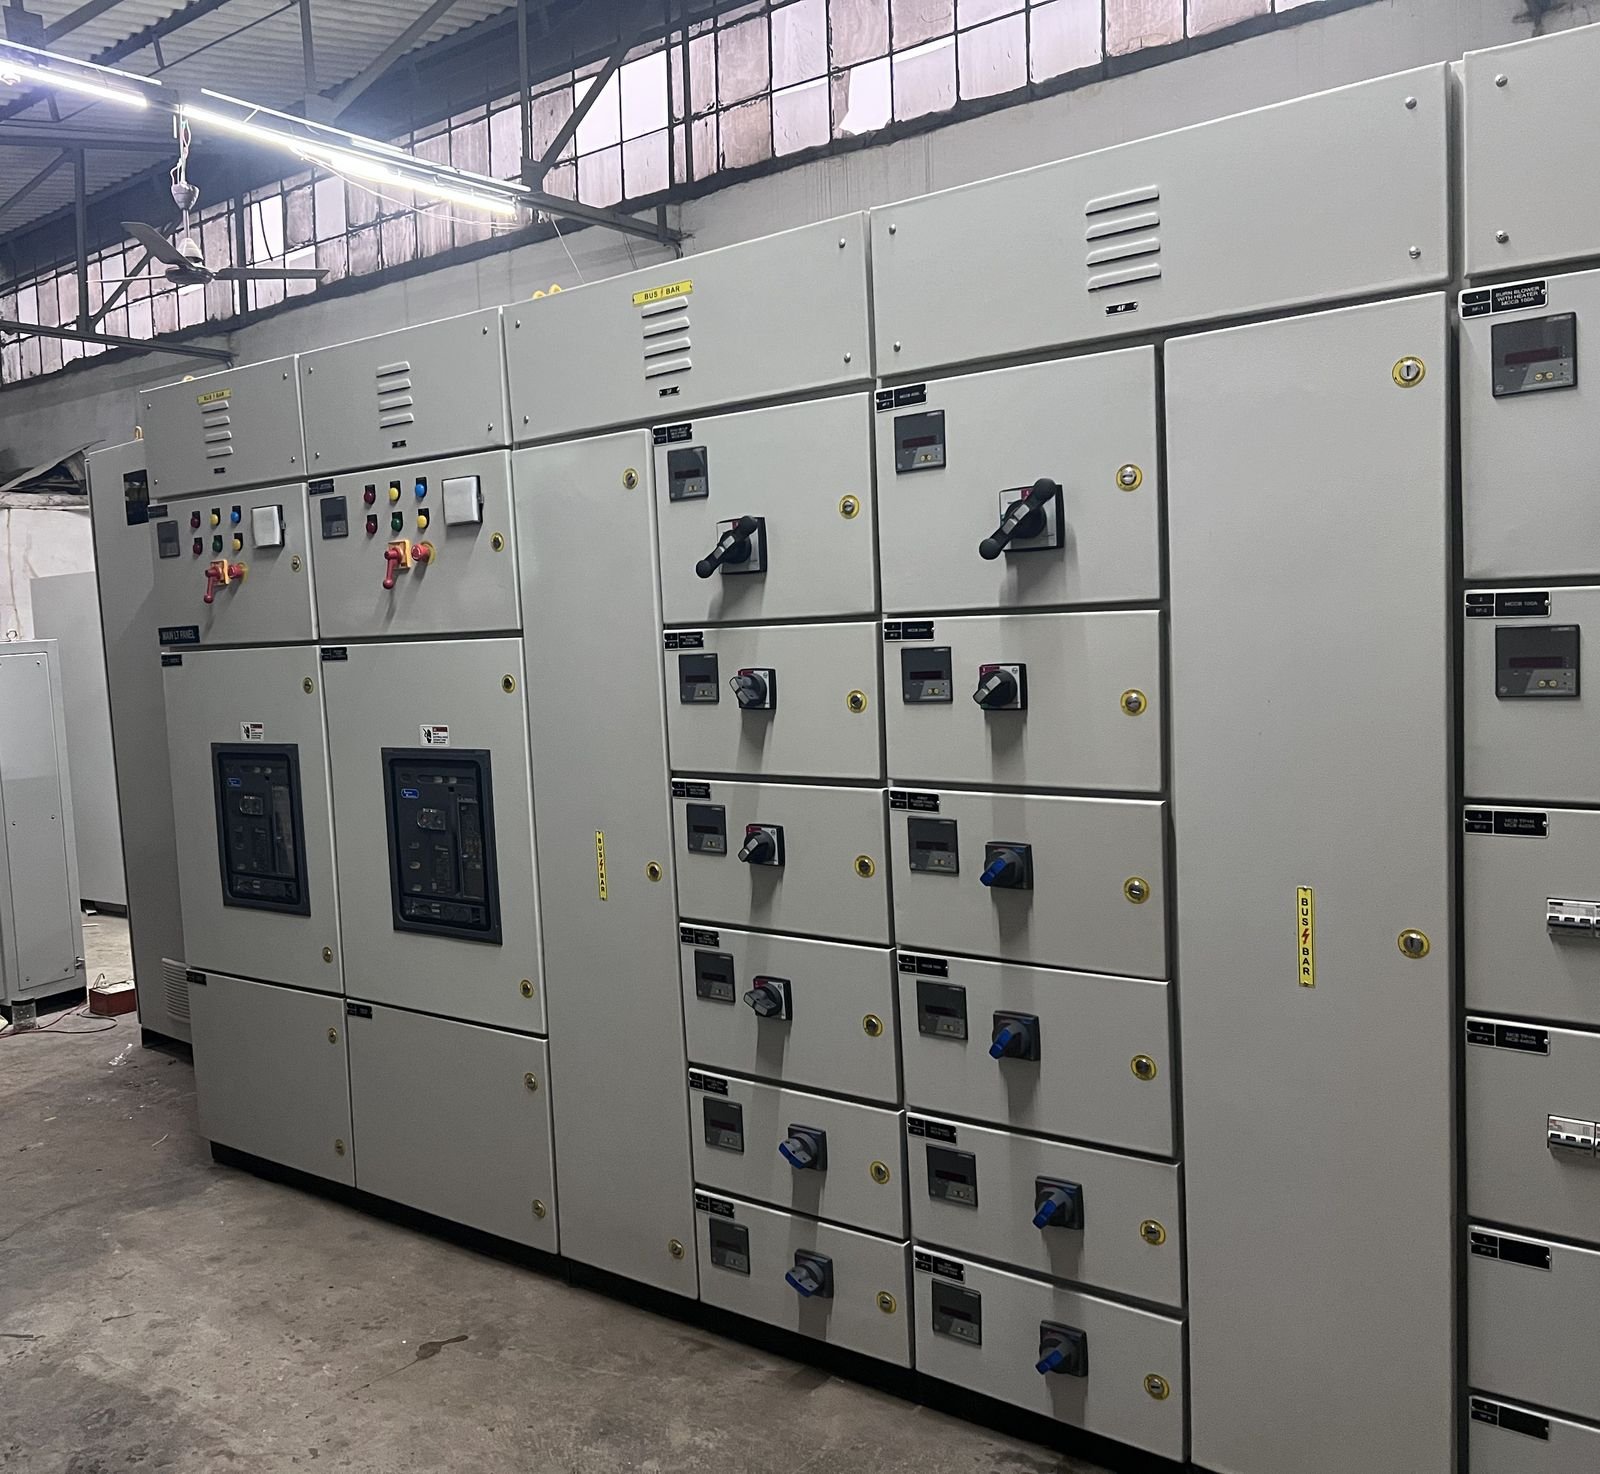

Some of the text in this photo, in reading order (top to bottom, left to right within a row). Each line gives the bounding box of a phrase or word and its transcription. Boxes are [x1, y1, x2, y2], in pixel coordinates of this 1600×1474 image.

[644, 285, 680, 300] BUS BAR
[1513, 286, 1540, 295] BLOWER
[1513, 290, 1538, 299] HEATER
[1301, 898, 1309, 926] BUS
[1302, 947, 1310, 976] BAR
